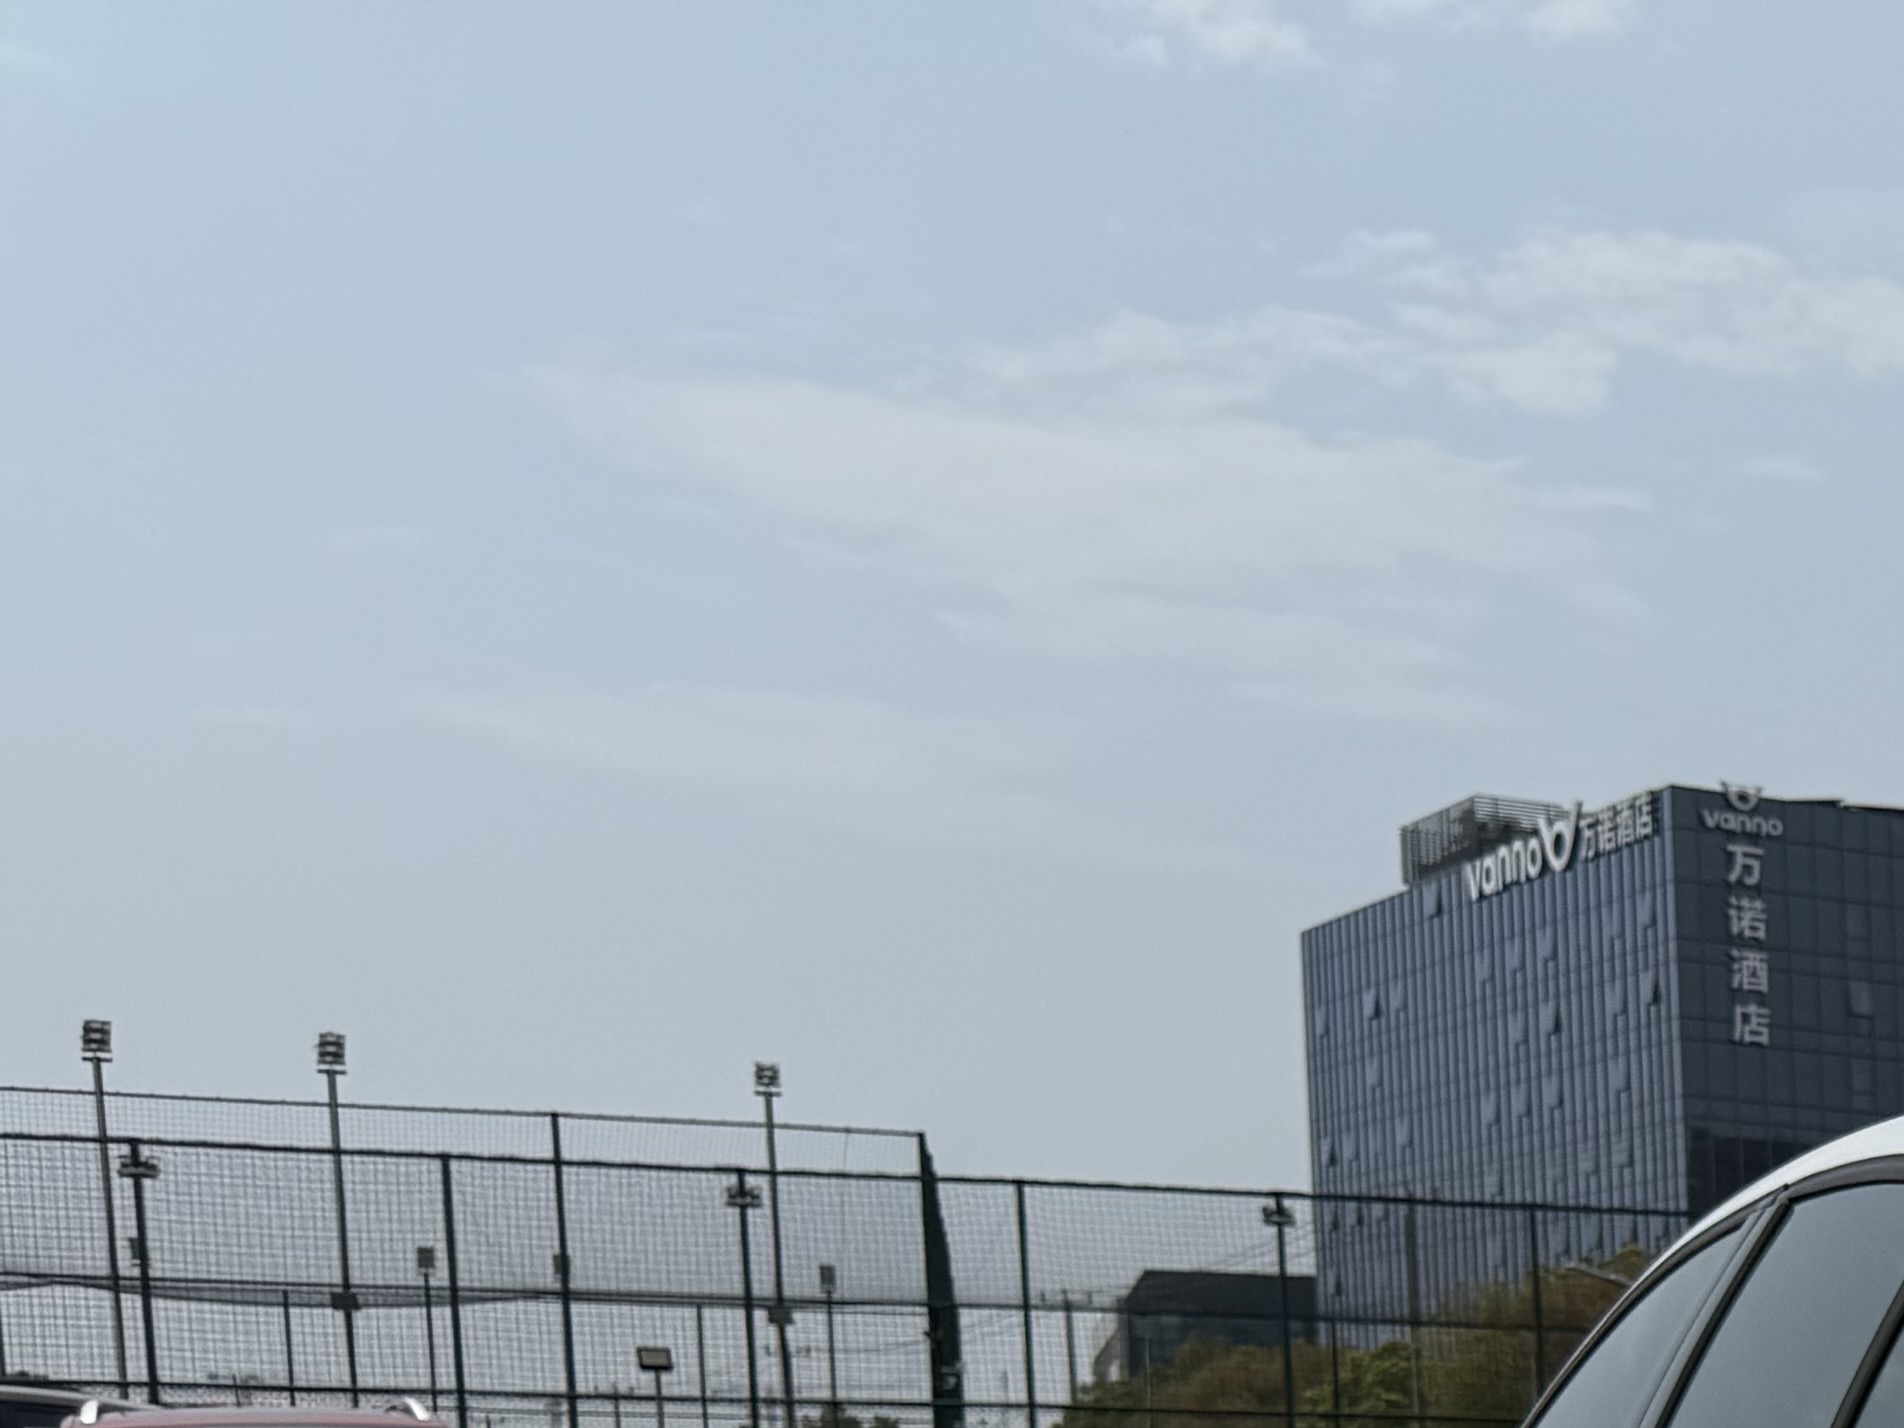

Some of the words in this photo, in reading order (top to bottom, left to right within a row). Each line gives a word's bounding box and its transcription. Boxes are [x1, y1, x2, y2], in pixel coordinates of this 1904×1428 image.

[1579, 793, 1656, 862] 万诺酒店
[1699, 806, 1785, 838] vanno
[1466, 836, 1543, 901] vanno
[1725, 842, 1772, 1048] 万诺酒店
